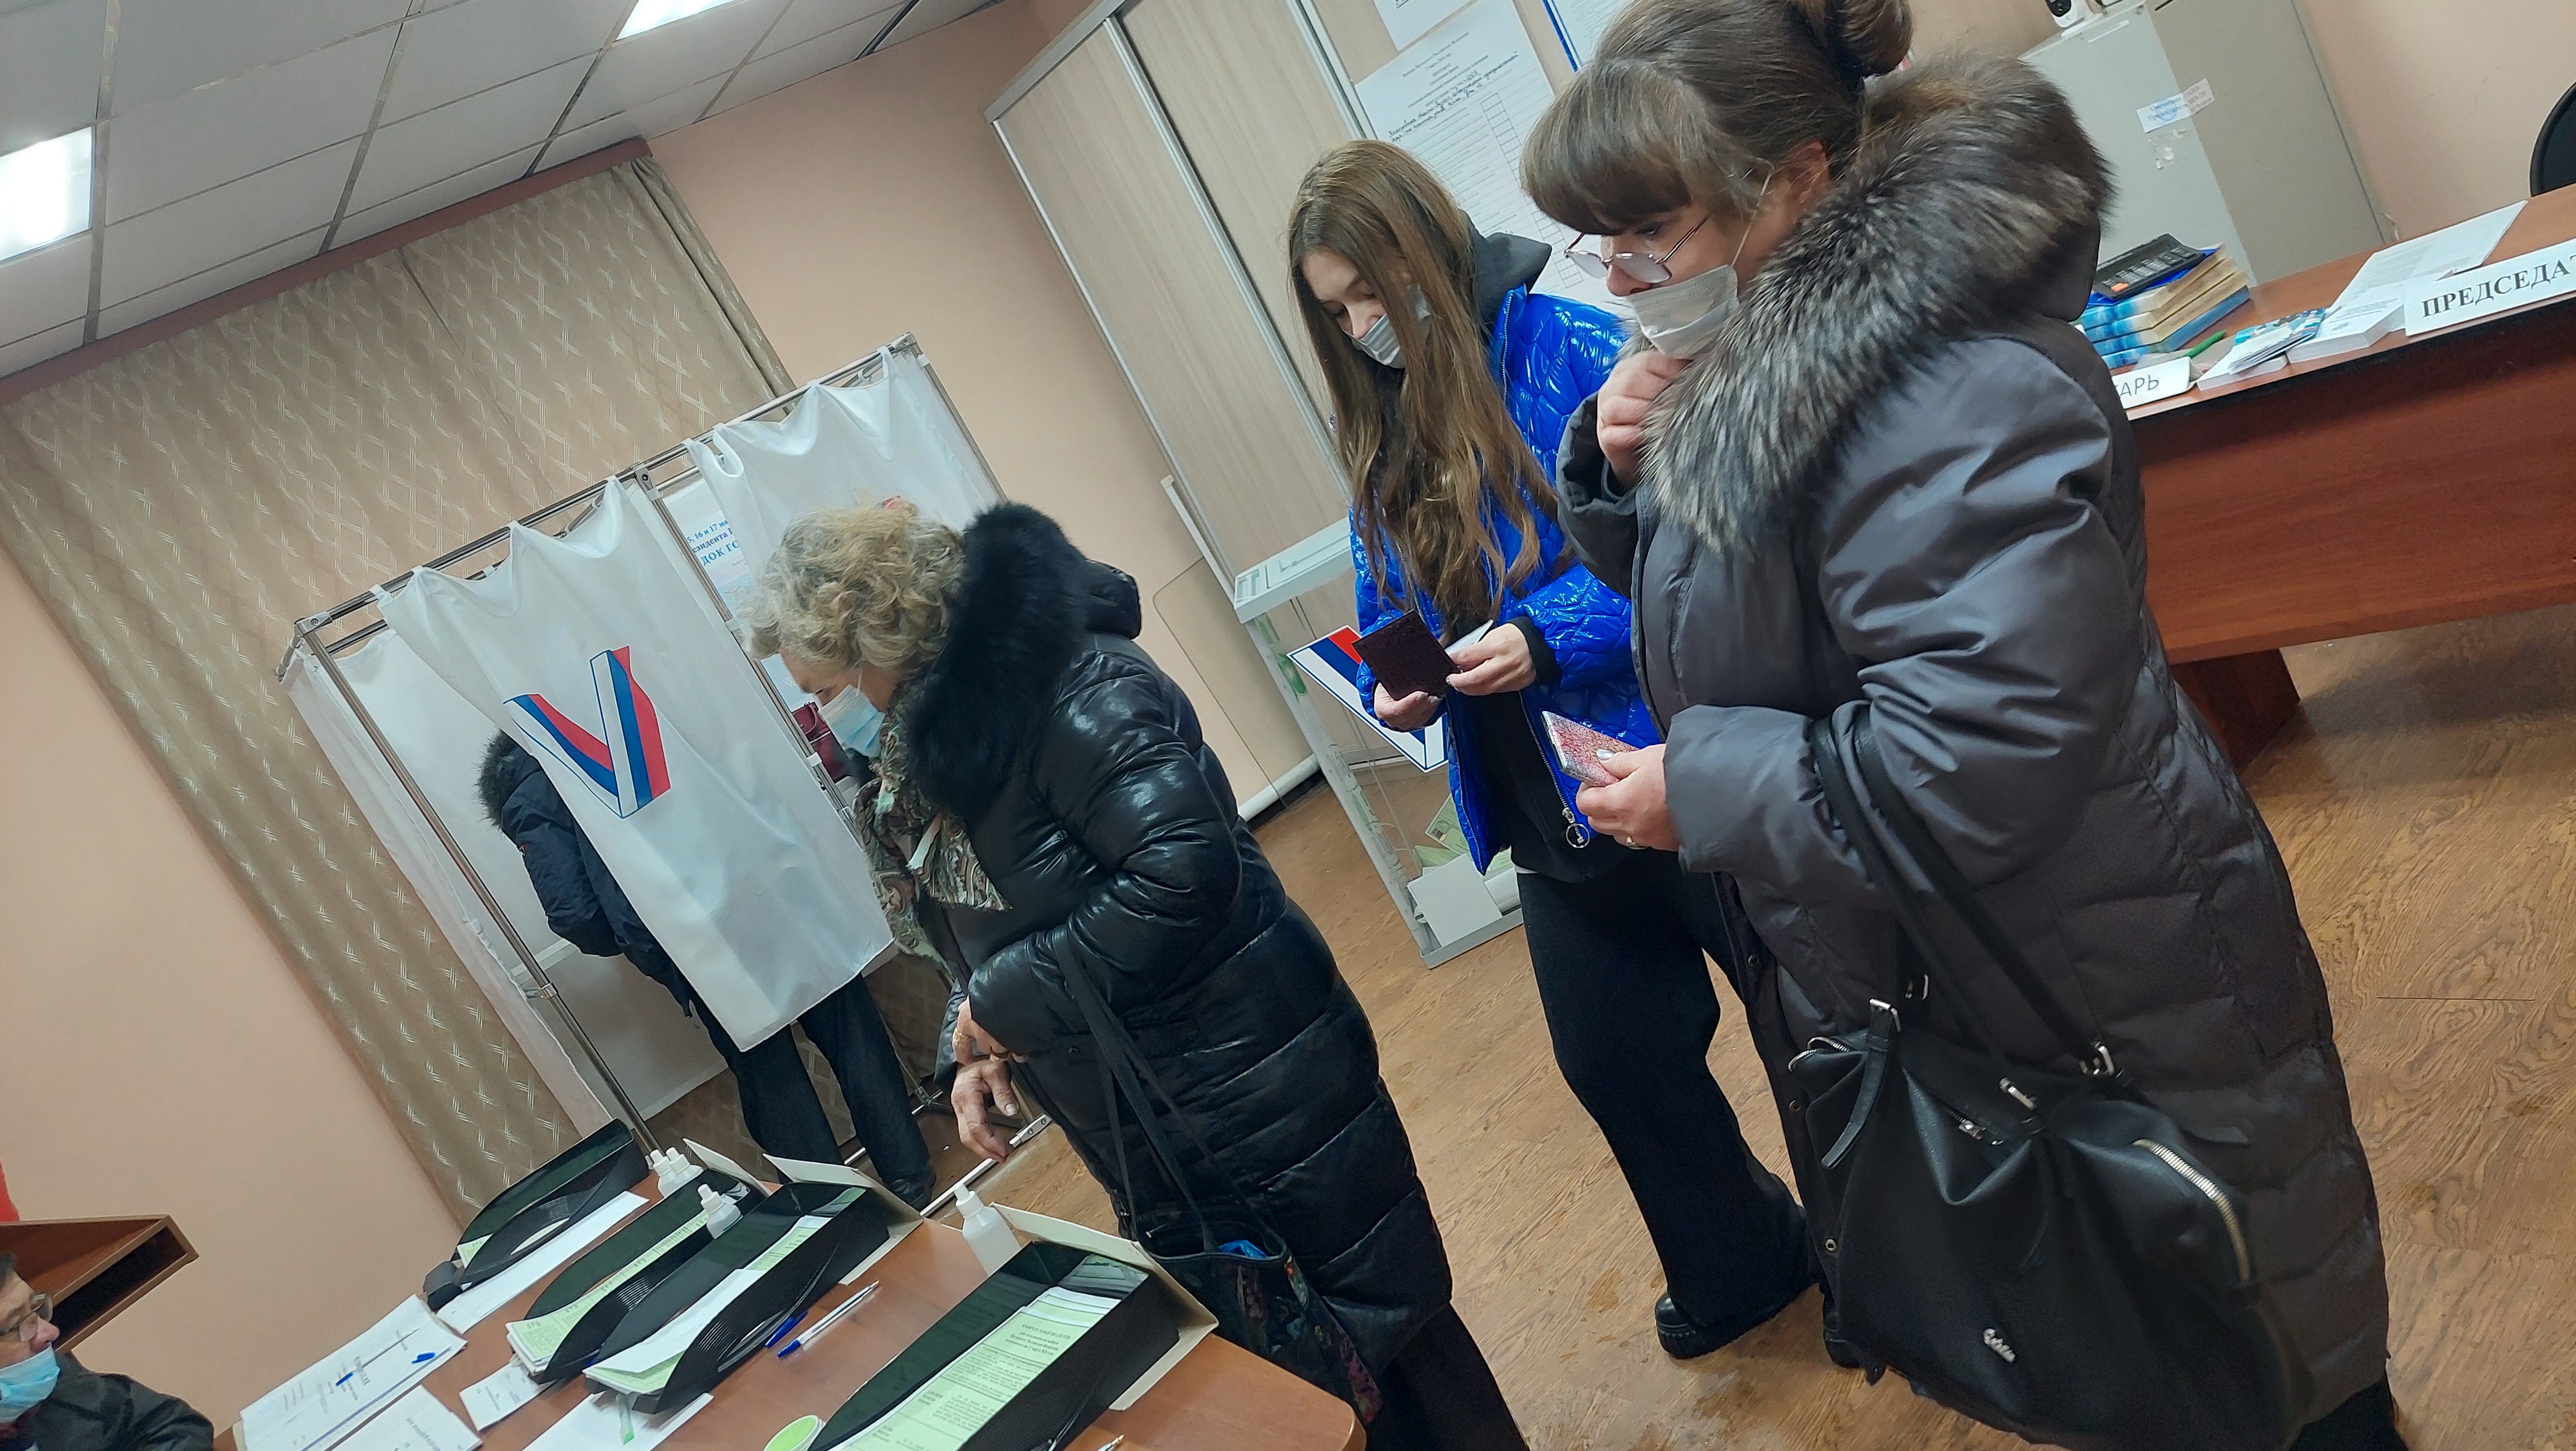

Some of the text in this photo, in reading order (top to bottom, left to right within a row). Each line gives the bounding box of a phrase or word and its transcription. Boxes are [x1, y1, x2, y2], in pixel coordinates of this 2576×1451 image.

[2115, 374, 2159, 397] АРЬ
[694, 530, 704, 539] 16
[709, 523, 718, 532] 17
[718, 519, 728, 528] ма
[701, 547, 725, 566] ДОК
